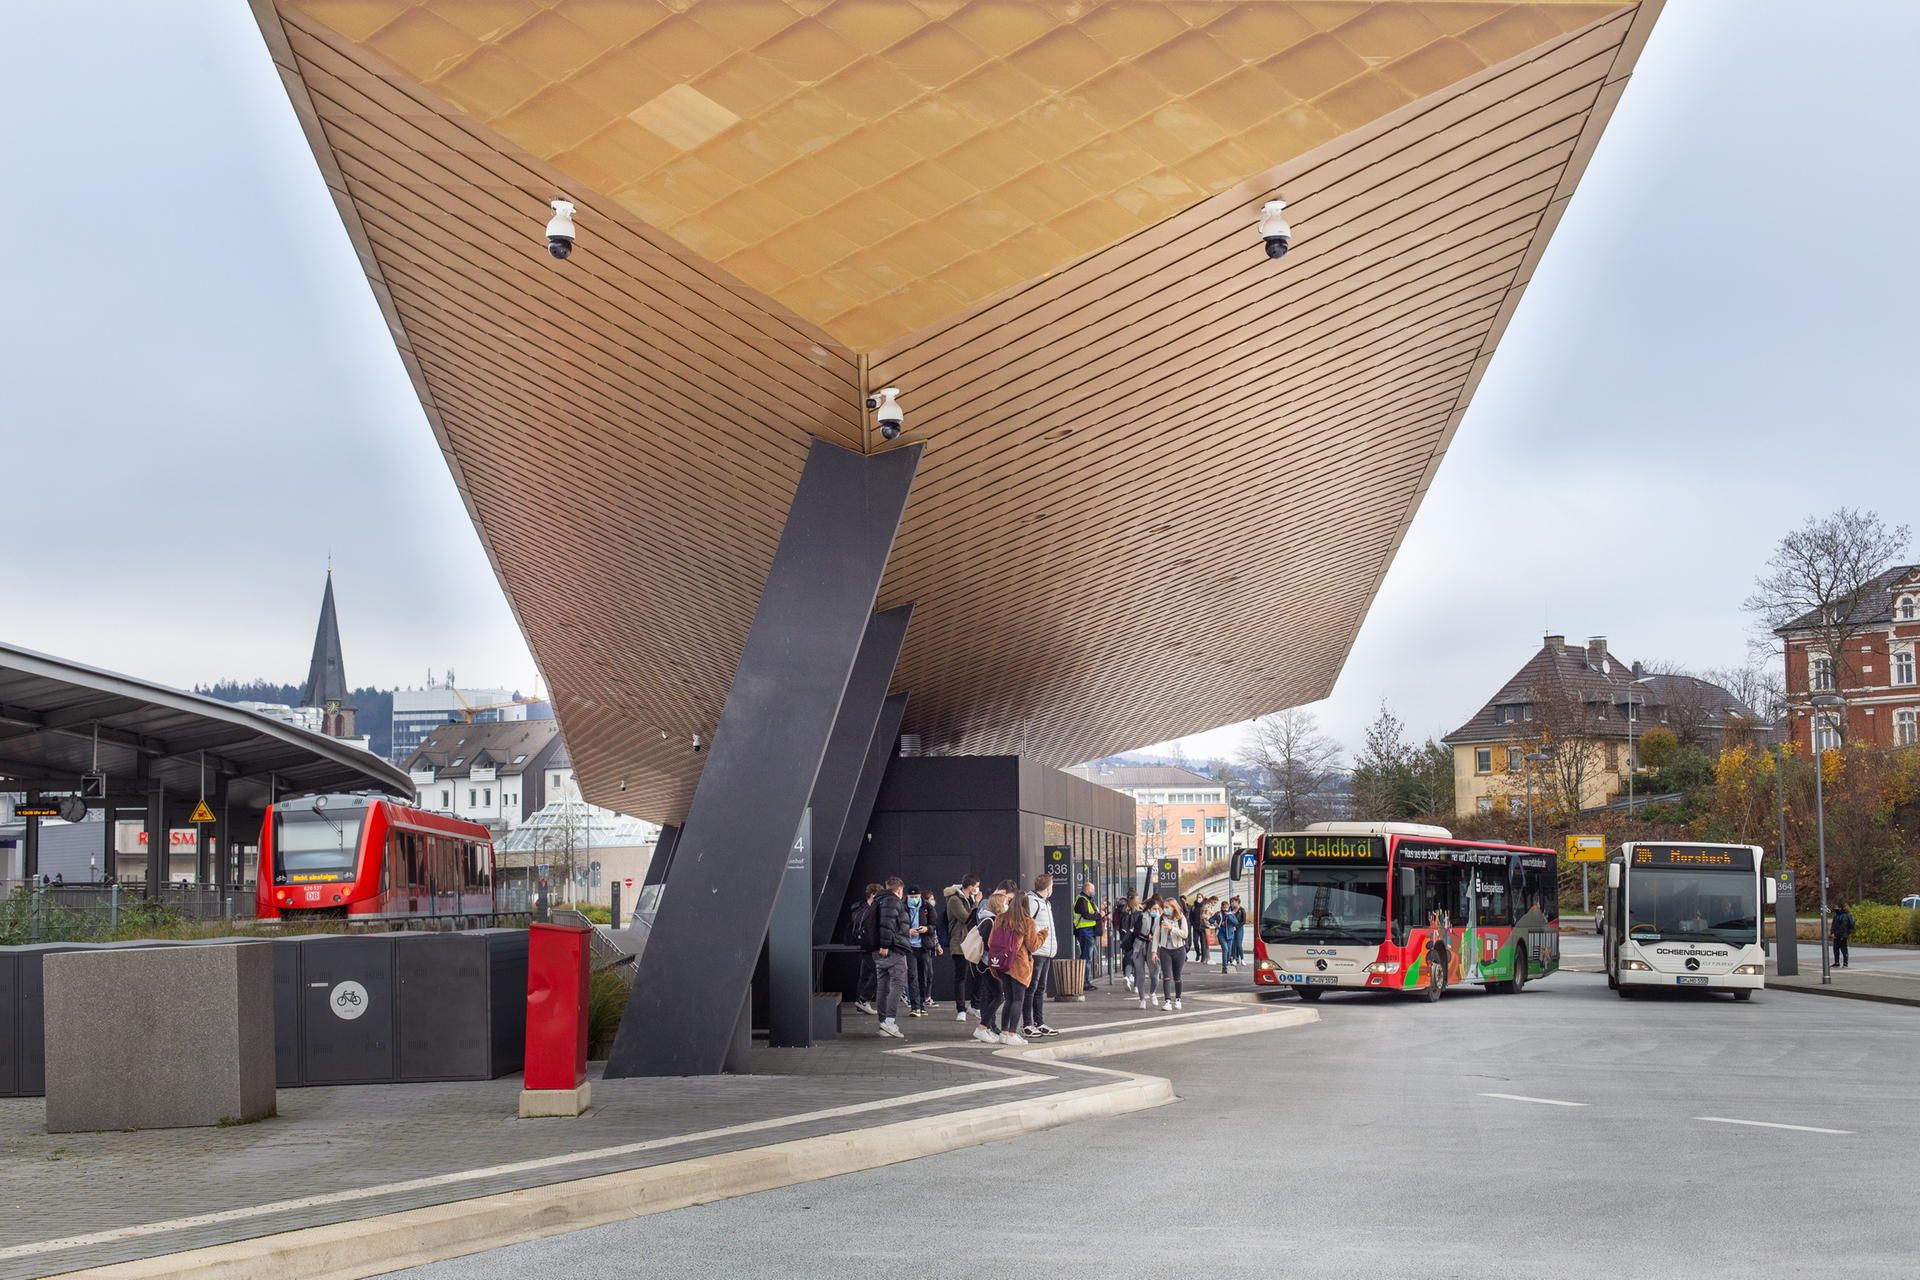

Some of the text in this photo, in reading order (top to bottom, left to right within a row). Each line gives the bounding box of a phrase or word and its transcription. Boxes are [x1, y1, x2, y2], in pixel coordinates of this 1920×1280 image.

[1271, 838, 1371, 857] 303 Waldbröl
[1670, 850, 1732, 864] Morsbach
[1048, 864, 1068, 874] 336
[1160, 872, 1176, 880] 310
[1656, 948, 1728, 957] OCHSENBRÜCHER
